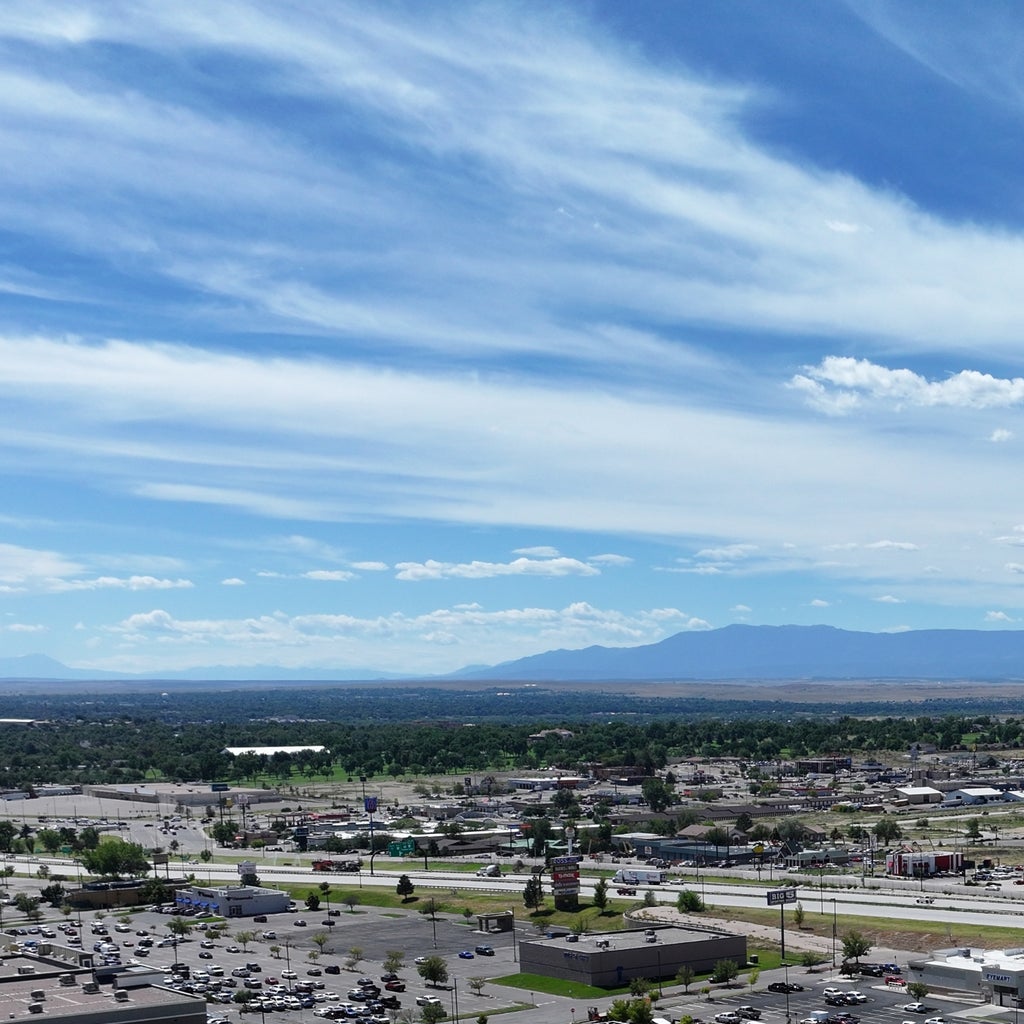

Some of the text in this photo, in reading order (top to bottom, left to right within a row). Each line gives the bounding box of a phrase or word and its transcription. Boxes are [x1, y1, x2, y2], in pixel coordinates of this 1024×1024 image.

[771, 891, 795, 900] BIG 5
[986, 973, 1011, 982] EYEMART
